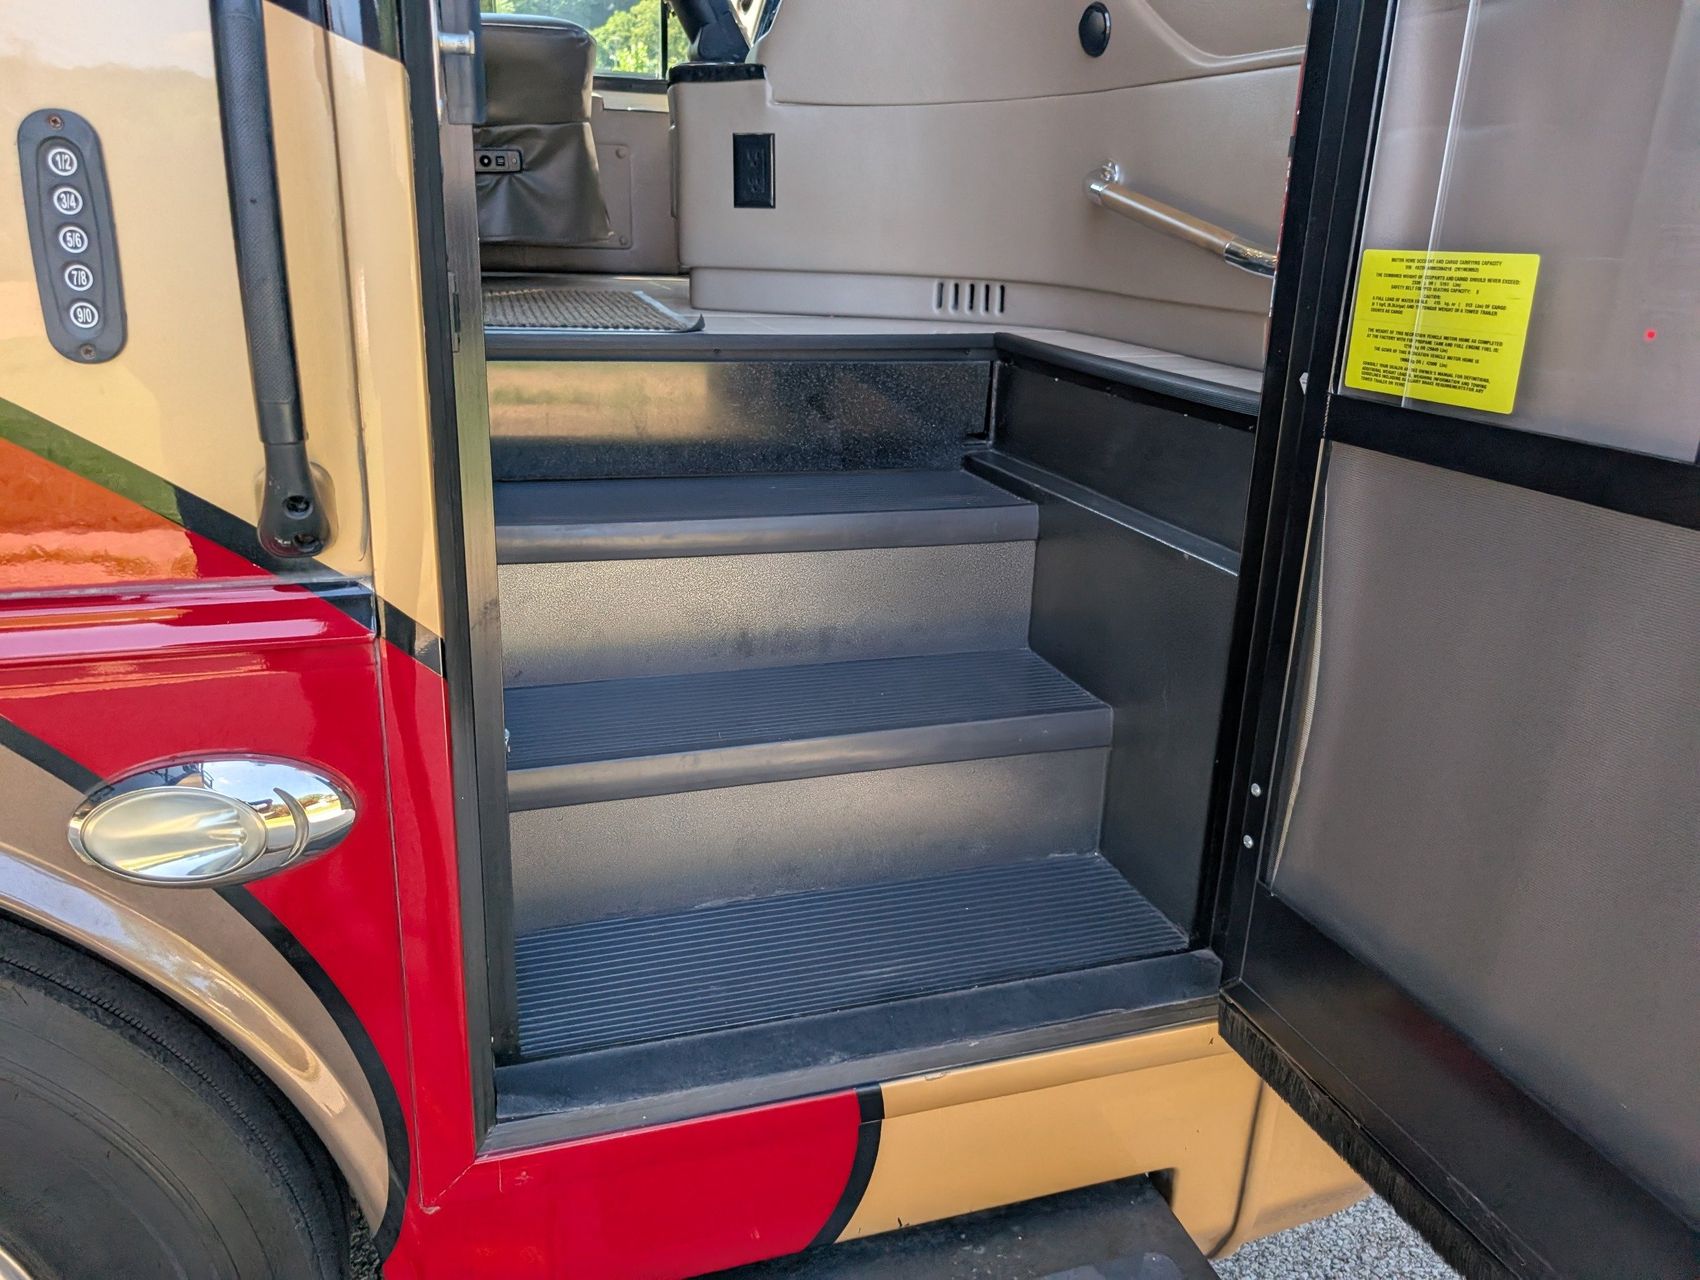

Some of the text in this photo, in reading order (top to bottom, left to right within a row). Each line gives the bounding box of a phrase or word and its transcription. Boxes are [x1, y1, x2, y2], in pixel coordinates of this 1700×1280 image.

[55, 154, 72, 170] 1/2
[60, 194, 76, 209] 3/4
[65, 232, 82, 248] 5/6
[71, 270, 87, 286] 7/8
[76, 308, 92, 322] 9/0
